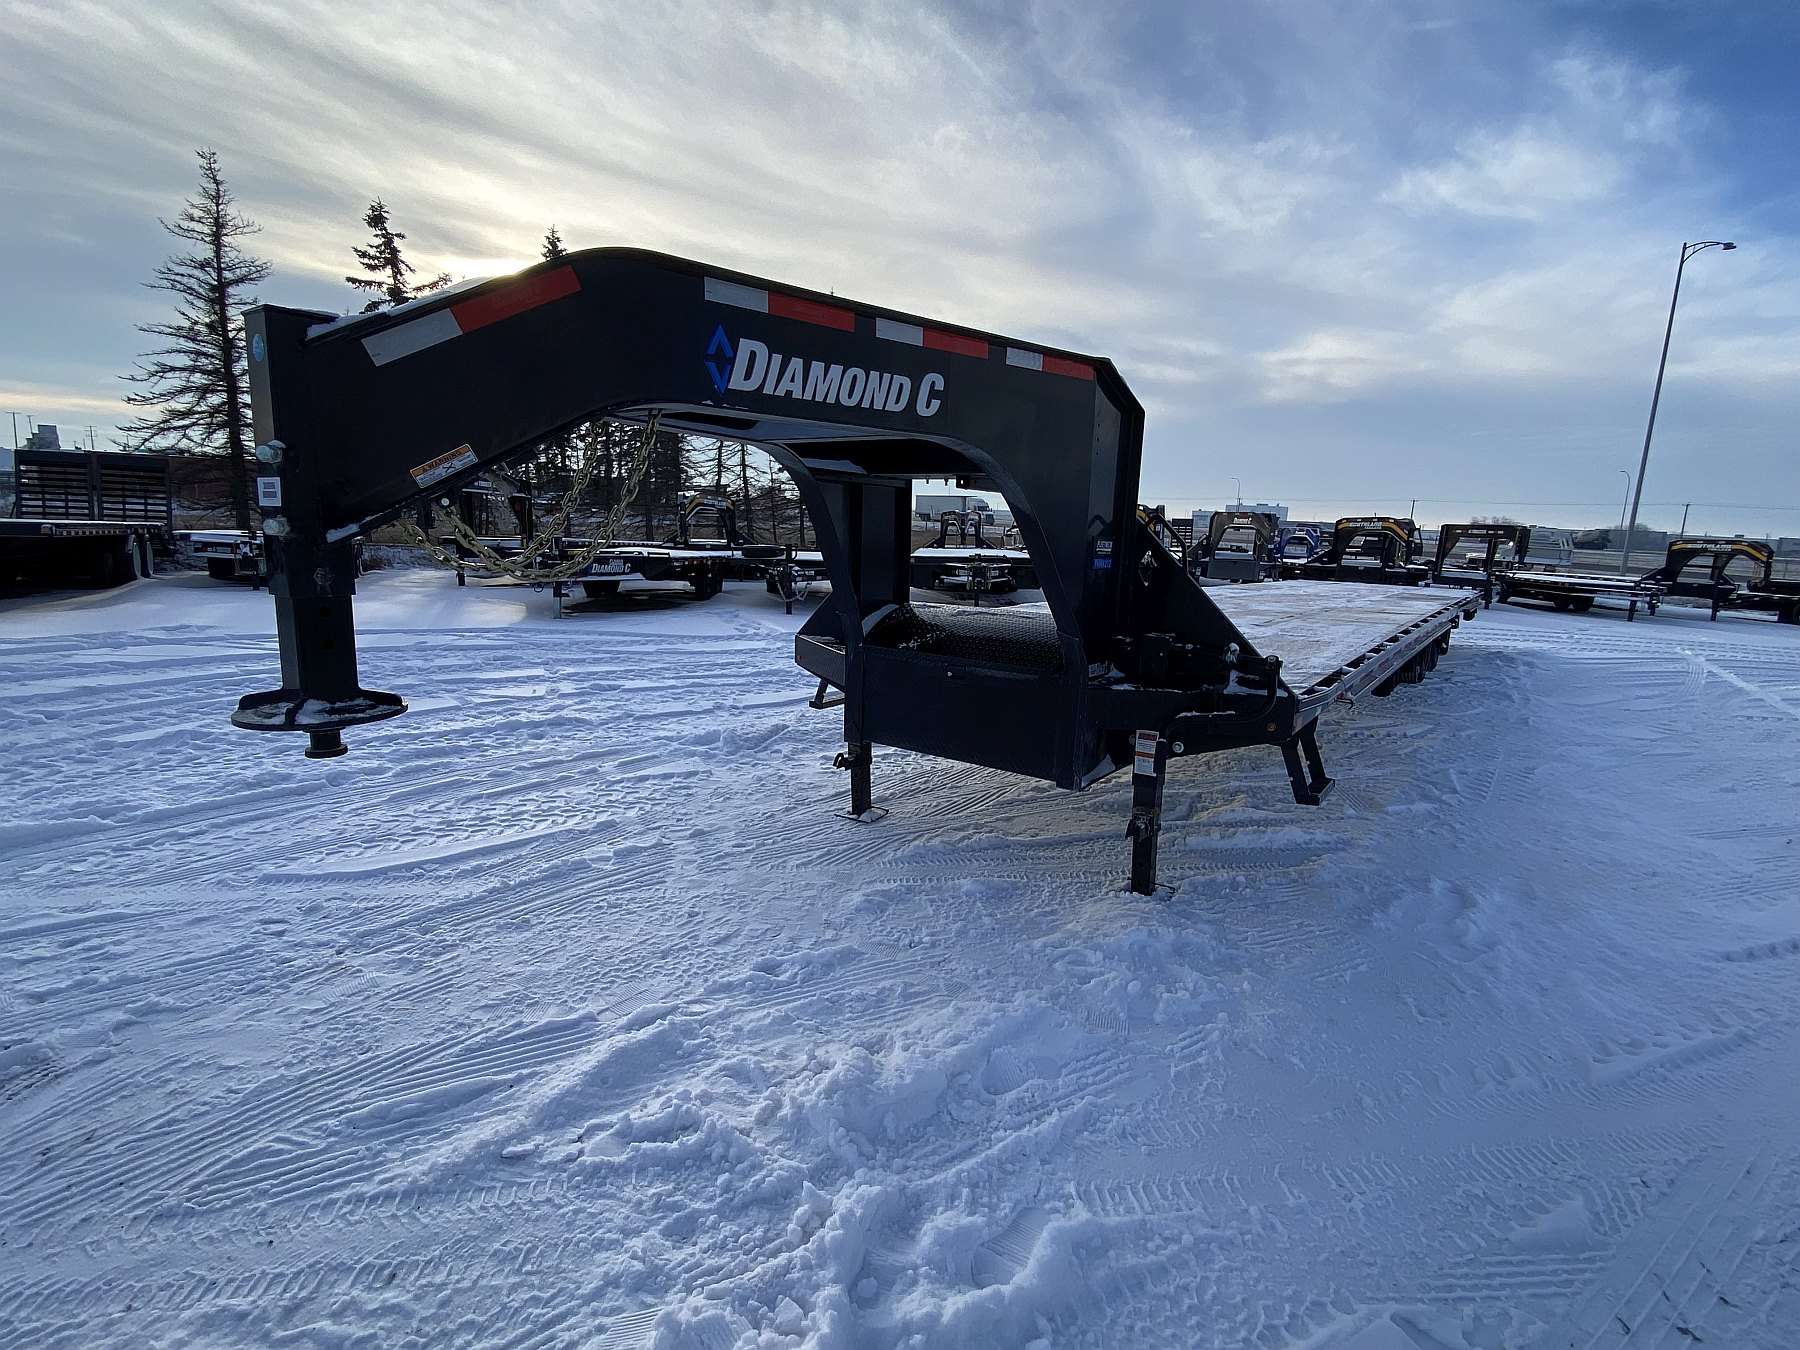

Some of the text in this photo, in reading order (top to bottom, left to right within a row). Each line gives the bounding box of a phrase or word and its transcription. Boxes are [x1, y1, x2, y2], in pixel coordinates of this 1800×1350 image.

[728, 338, 945, 417] DIAMOND C
[624, 563, 631, 573] C
